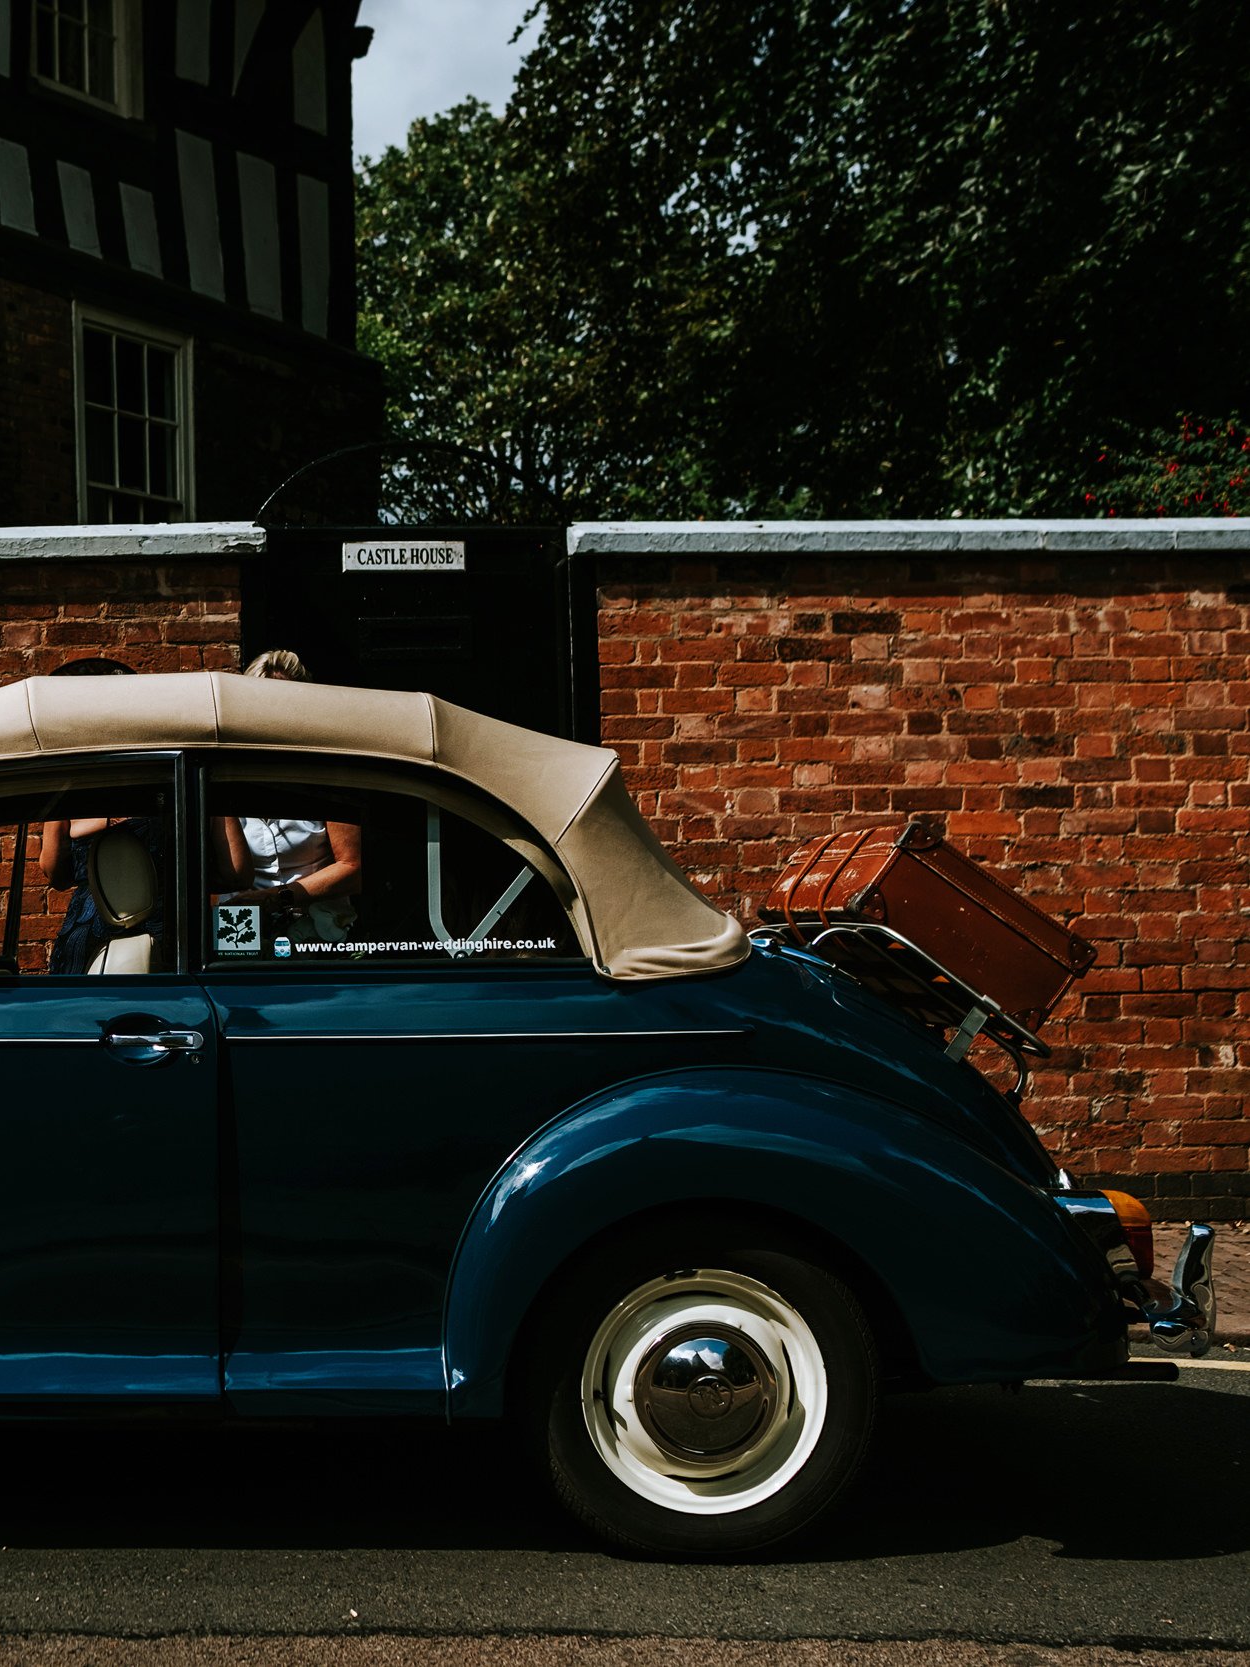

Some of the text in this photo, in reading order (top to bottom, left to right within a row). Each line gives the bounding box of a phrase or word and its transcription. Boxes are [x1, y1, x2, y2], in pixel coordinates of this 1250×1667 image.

[357, 547, 454, 565] CASTLE HOUSE
[295, 937, 556, 954] www.campervan-weddinghire.co.uk
